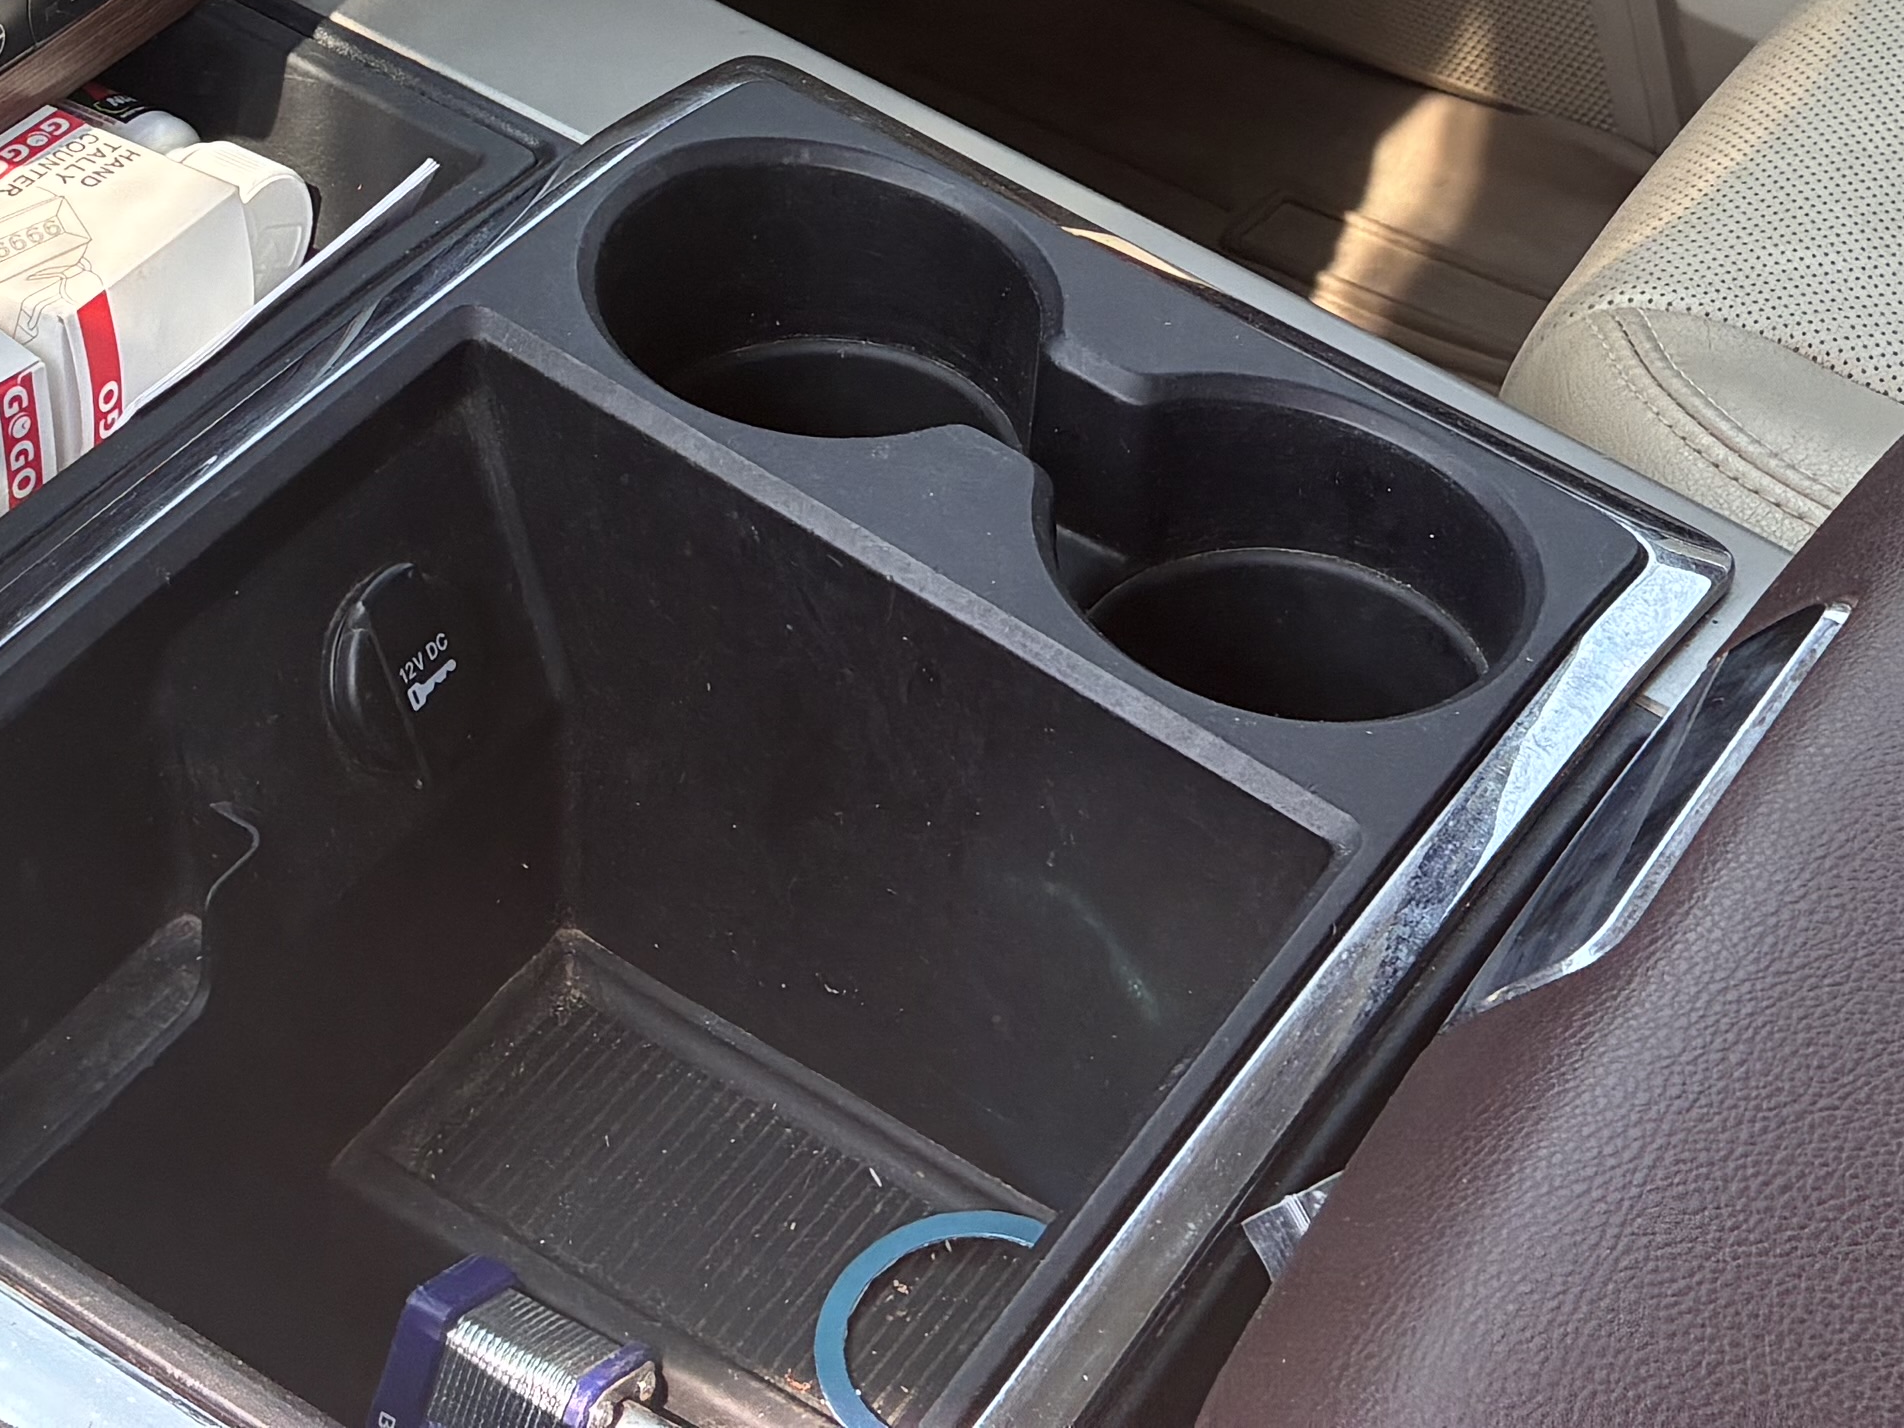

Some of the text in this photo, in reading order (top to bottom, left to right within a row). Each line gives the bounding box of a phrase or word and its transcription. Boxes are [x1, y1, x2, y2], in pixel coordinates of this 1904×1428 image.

[55, 142, 122, 185] TALLY
[80, 148, 142, 188] HAND
[2, 384, 38, 499] GOGO
[399, 632, 448, 684] 12V DC
